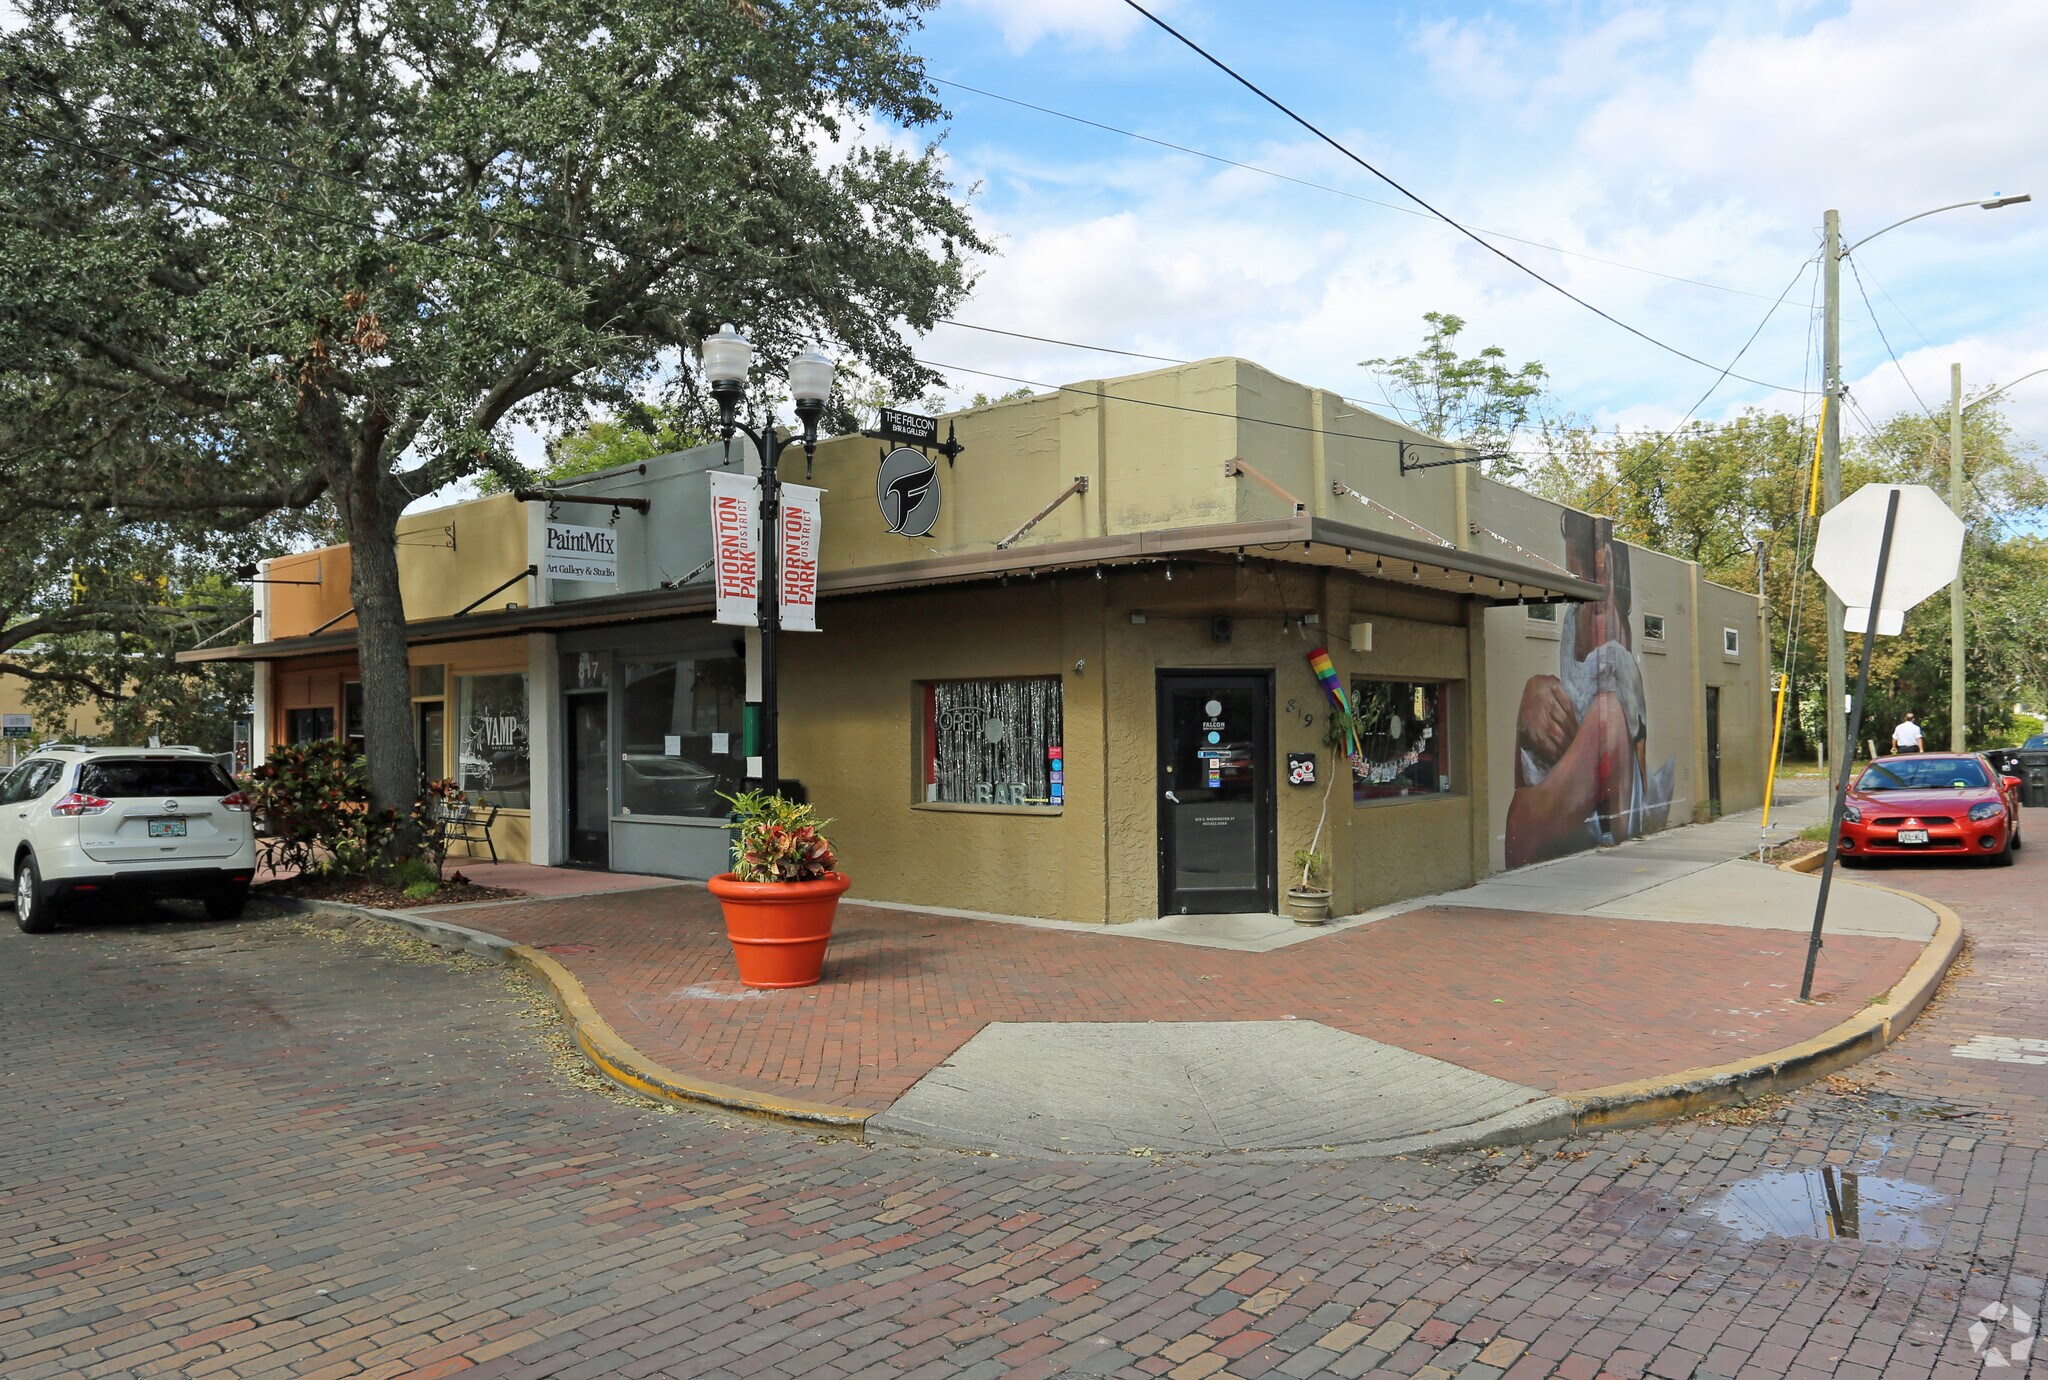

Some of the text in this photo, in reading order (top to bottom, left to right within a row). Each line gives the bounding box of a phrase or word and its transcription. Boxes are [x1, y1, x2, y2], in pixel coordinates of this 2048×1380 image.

[885, 411, 935, 431] THE FALCON
[892, 424, 902, 432] BAR
[906, 426, 928, 437] GALLERY
[546, 528, 615, 554] PaintMix
[718, 496, 740, 599] THORNTON
[738, 499, 756, 599] PARK DISTRICT
[785, 506, 803, 606] THORNTON
[799, 510, 816, 605] PARK DISTRICT
[546, 564, 615, 577] Art Gallery & Studio
[578, 661, 599, 679] 817
[939, 711, 985, 733] OPEN
[1286, 699, 1313, 728] 819
[484, 716, 517, 746] VAMP
[975, 781, 1028, 805] BAR
